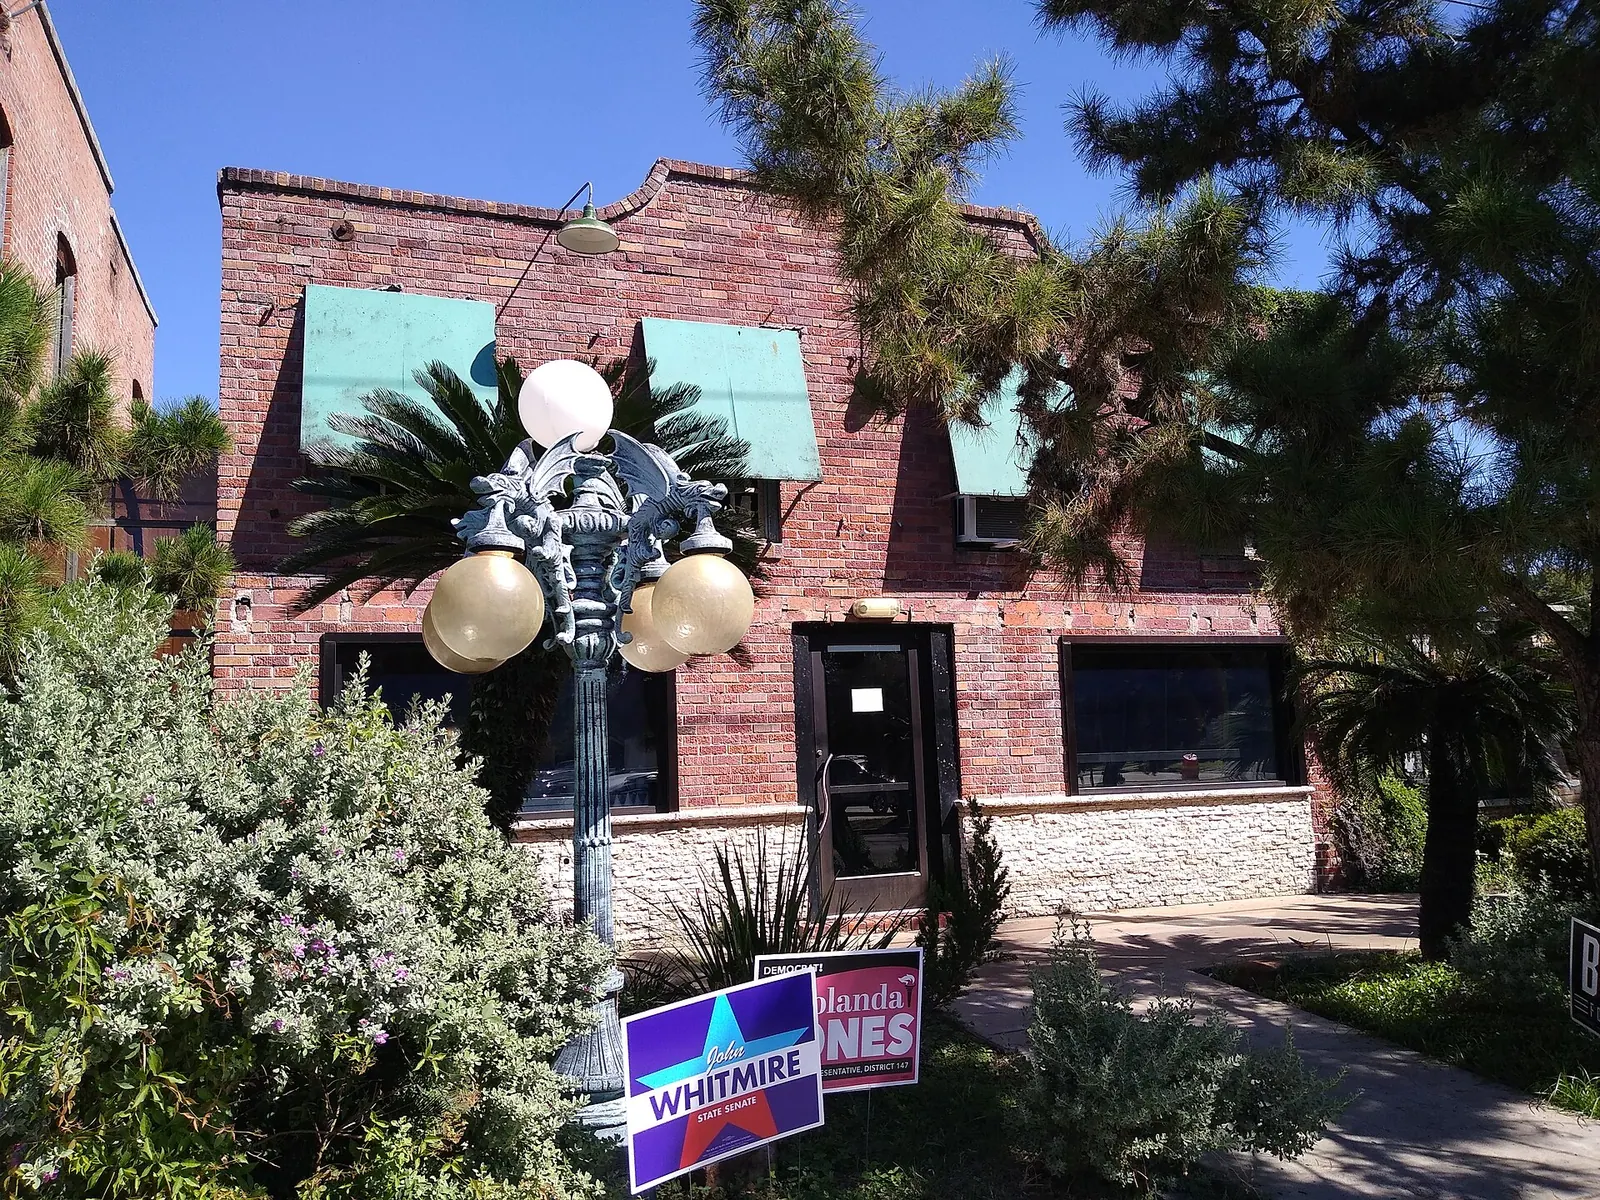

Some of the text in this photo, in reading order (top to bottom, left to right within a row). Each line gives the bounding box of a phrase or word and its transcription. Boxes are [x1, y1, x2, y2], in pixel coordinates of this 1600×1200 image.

[818, 1012, 915, 1061] NES
[707, 1040, 746, 1075] John
[864, 1062, 895, 1073] DISTRICT
[896, 1061, 909, 1070] 147
[649, 1049, 801, 1121] WHITMIRE
[697, 1096, 757, 1123] STATE SENATE
